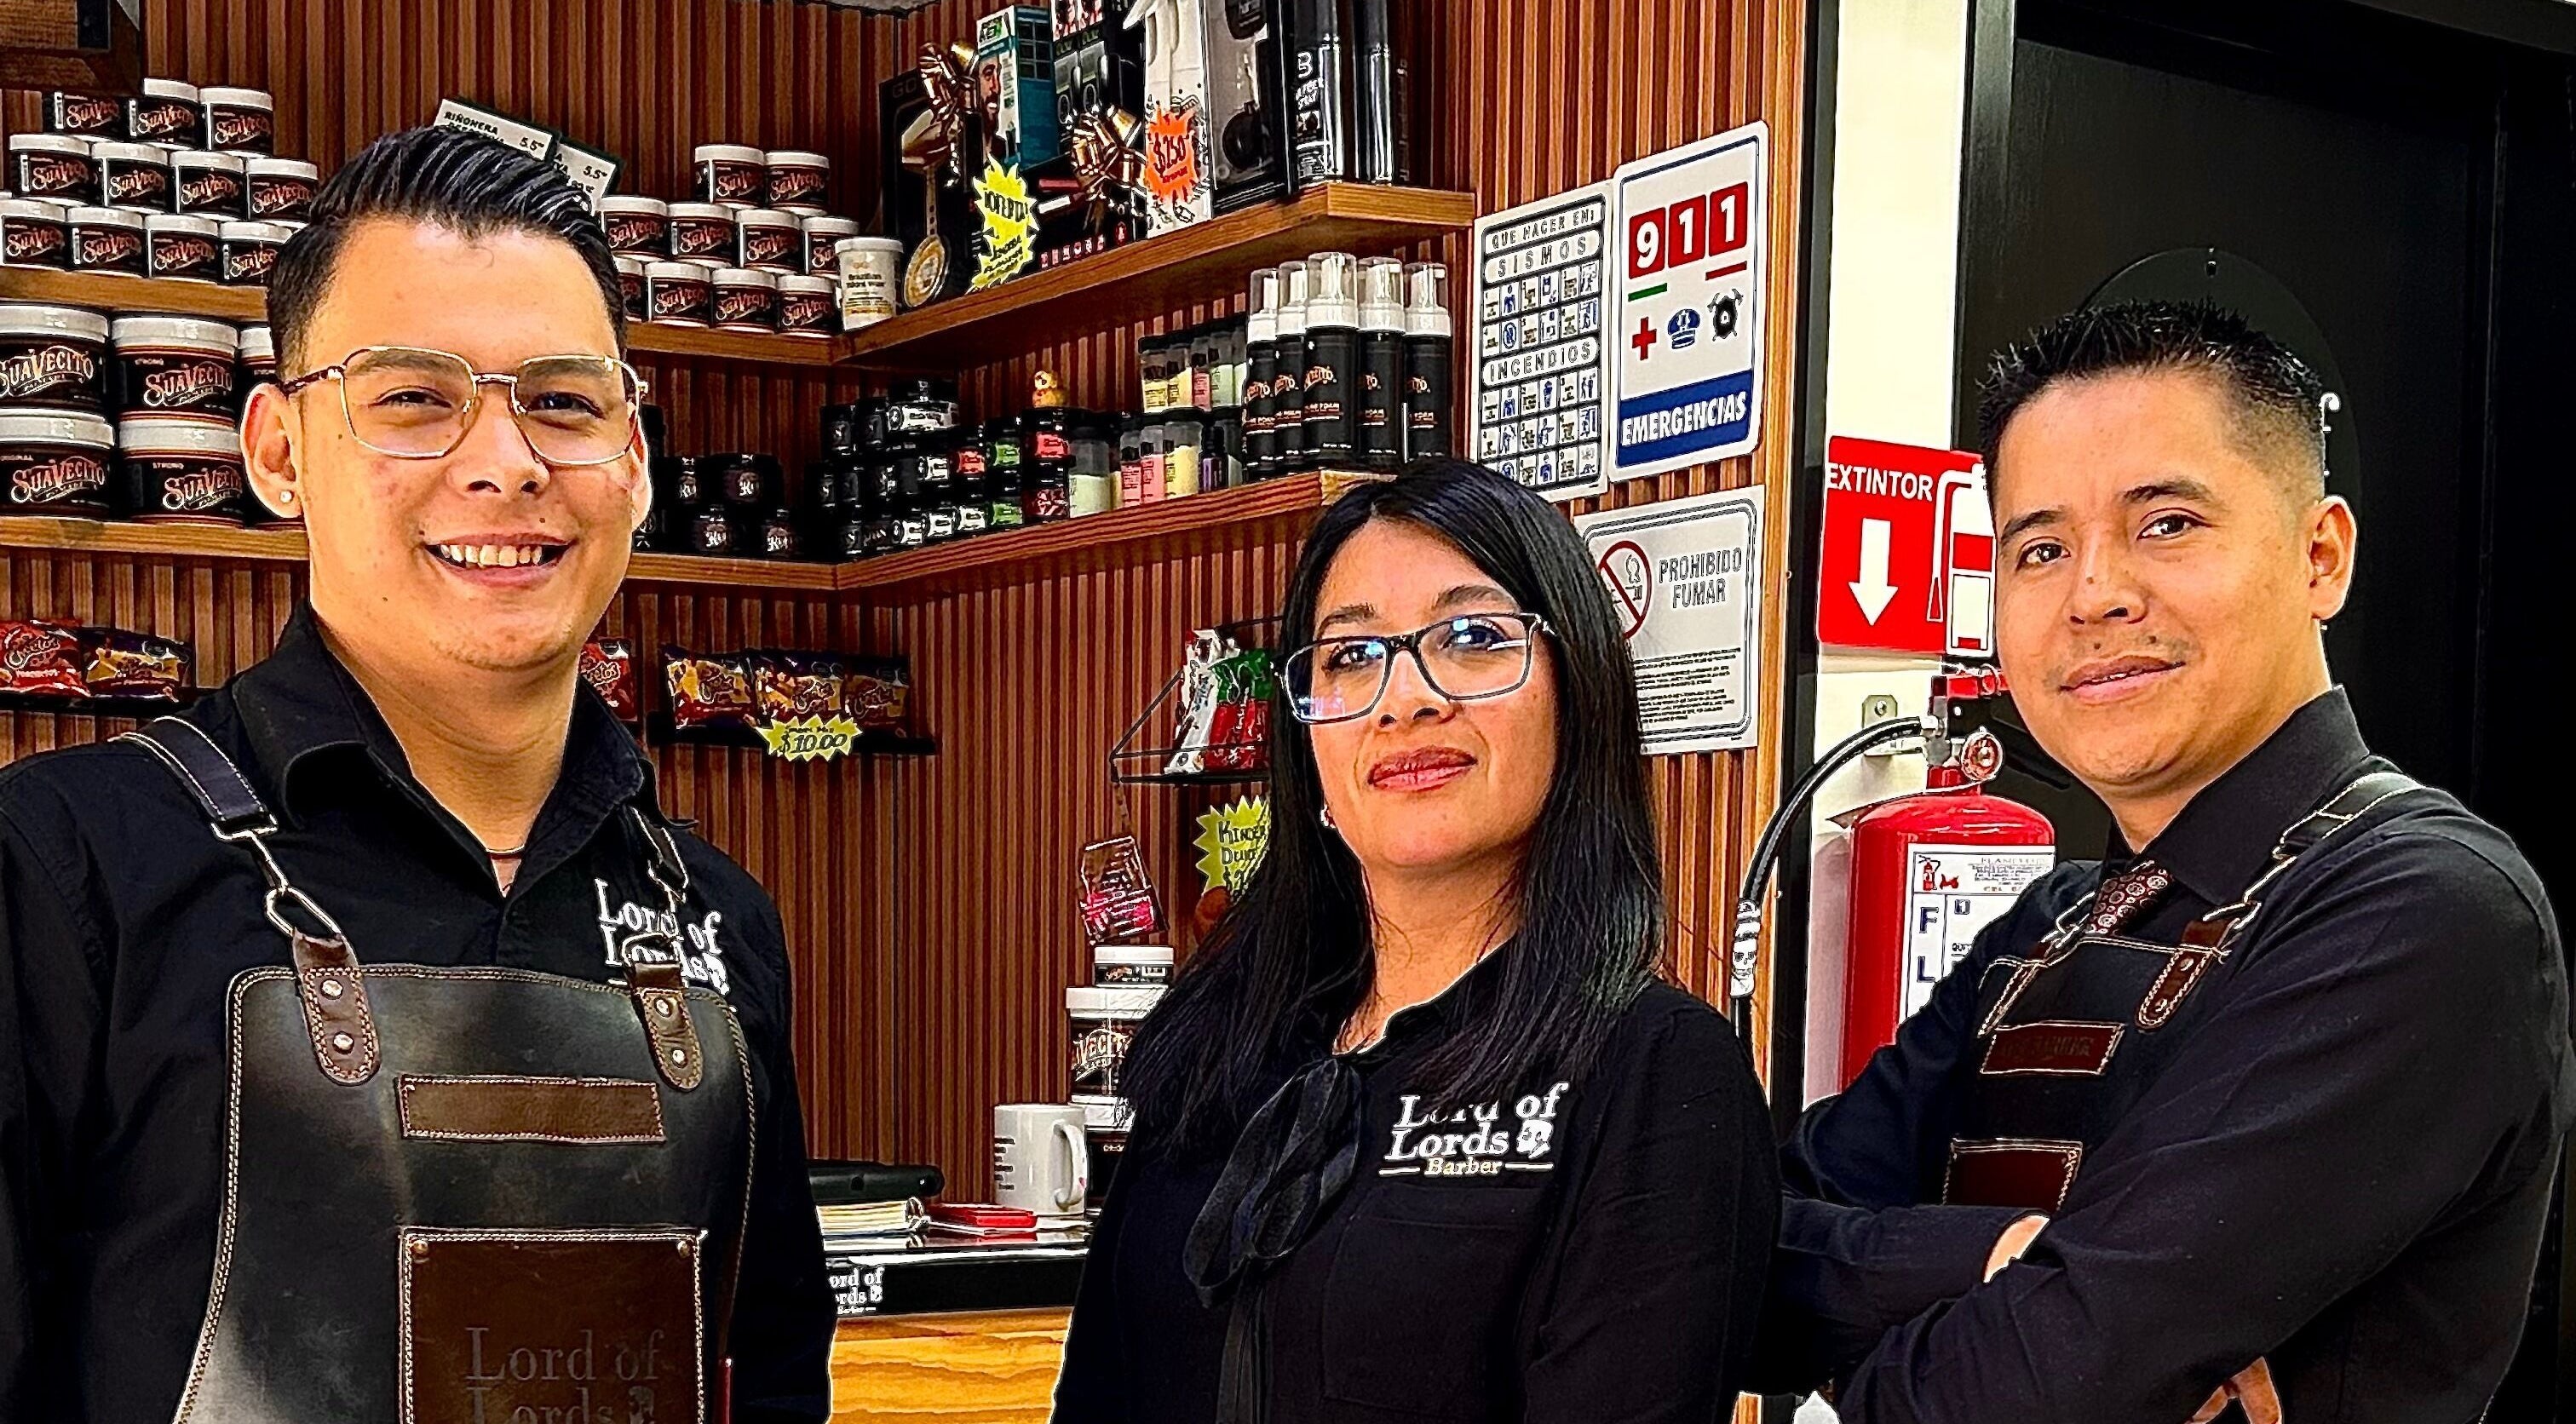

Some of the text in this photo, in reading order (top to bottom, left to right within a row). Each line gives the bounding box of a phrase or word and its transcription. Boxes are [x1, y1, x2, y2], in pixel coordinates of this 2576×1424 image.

[1492, 229, 1517, 250] QUE
[1522, 215, 1566, 241] HACER
[1636, 194, 1736, 270] 911
[1498, 234, 1587, 278] SISMOS
[1490, 341, 1591, 382] INCENDIOS
[1621, 391, 1747, 447] EMERGENCIAS
[1826, 462, 1934, 502] EXTINTOR
[1659, 547, 1742, 583] PROHIBIDO
[1672, 578, 1727, 609] FUMAR
[687, 910, 723, 955] of
[1919, 906, 1940, 934] F
[1917, 956, 1936, 984] L
[1515, 1082, 1569, 1118] of
[1383, 1121, 1509, 1161] Lords
[1423, 1156, 1503, 1177] Barber
[829, 1266, 885, 1289] ord of
[836, 1286, 867, 1305] rds
[464, 1326, 665, 1381] Lord of
